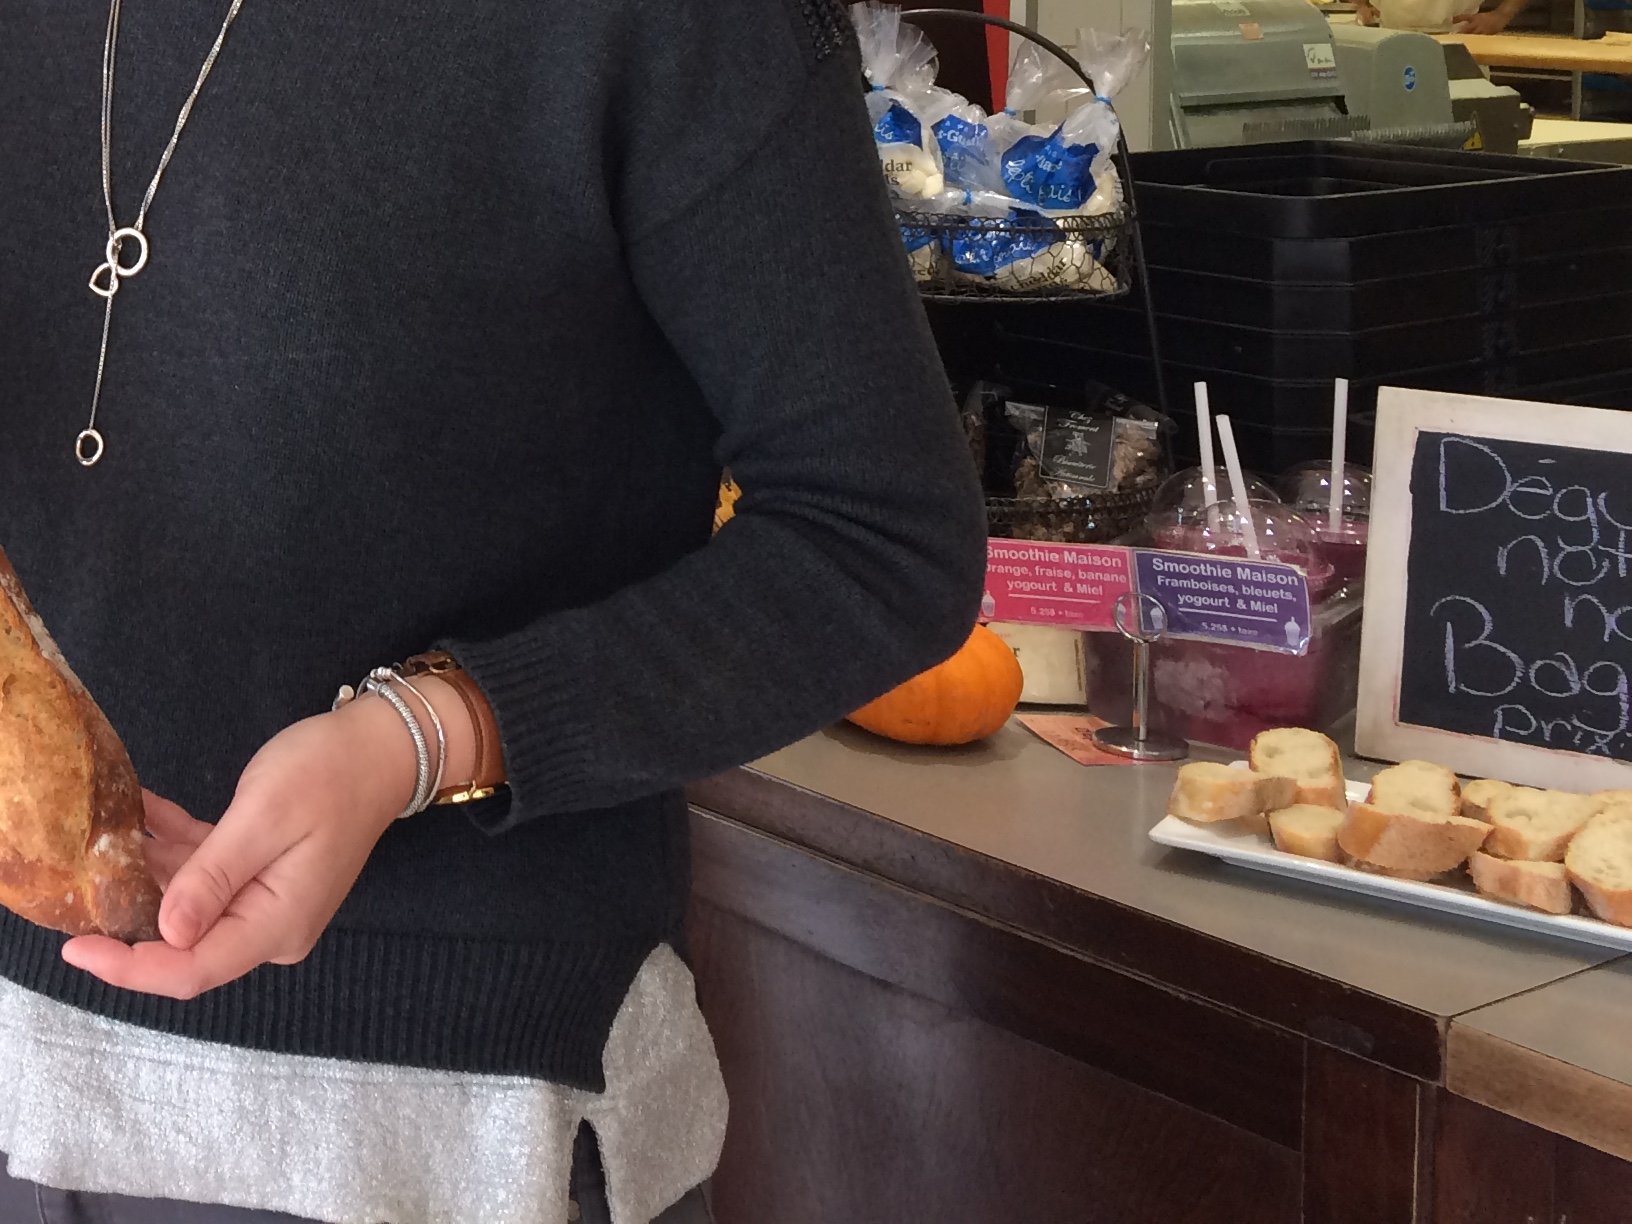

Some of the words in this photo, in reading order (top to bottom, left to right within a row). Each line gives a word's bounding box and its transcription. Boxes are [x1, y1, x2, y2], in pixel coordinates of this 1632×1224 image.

[987, 546, 1060, 563] Smoothie
[1063, 550, 1123, 568] Maison
[1034, 565, 1076, 581] fraise,
[1078, 568, 1128, 583] banane
[1152, 557, 1232, 579] Smoothie
[1236, 566, 1299, 587] Maison
[1006, 579, 1058, 591] yogourt
[1063, 582, 1074, 593] &
[1076, 583, 1104, 596] Miel
[1157, 574, 1240, 596] Framboises,
[1241, 584, 1297, 603] bleuets,
[1177, 592, 1231, 608] yogourt
[1236, 599, 1248, 610] &
[1250, 599, 1279, 614] Miel
